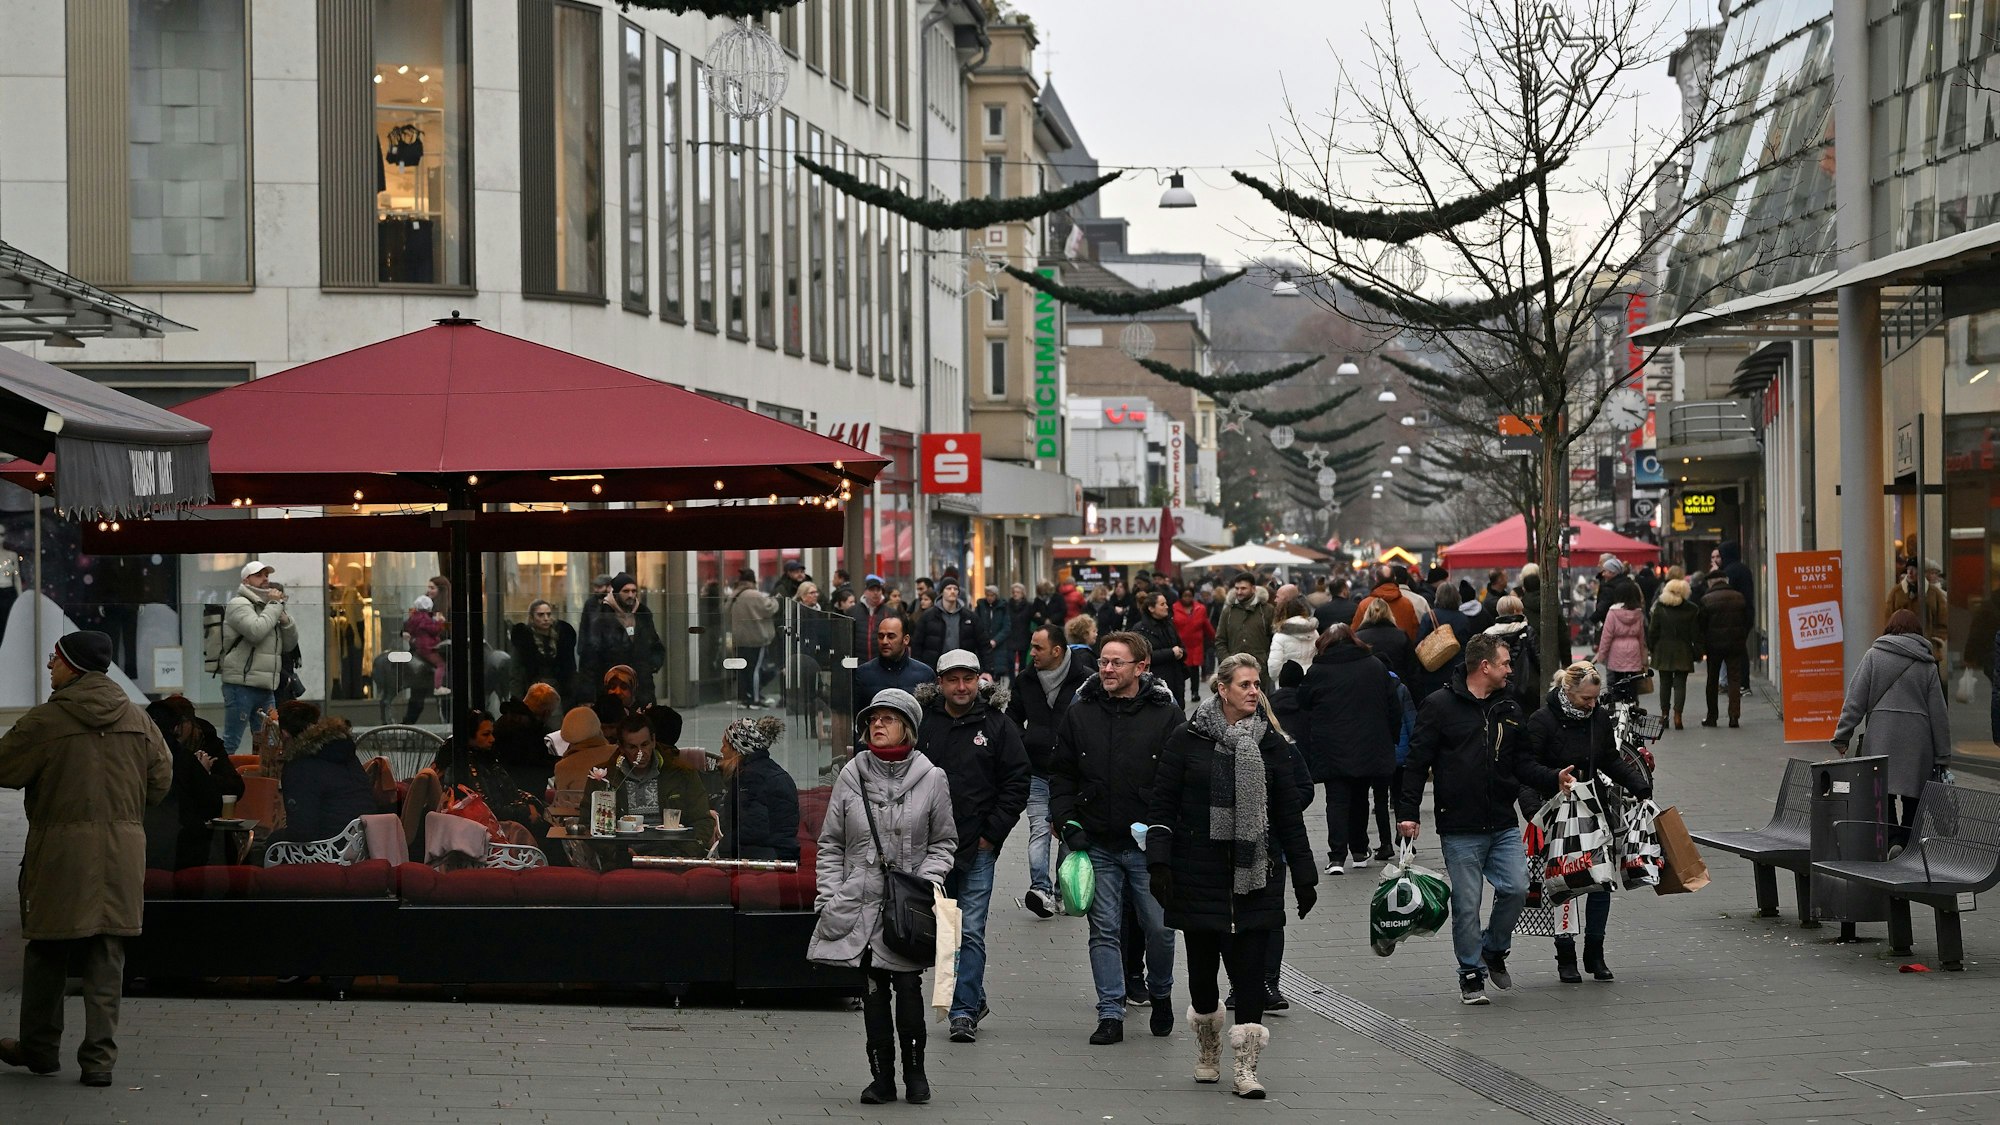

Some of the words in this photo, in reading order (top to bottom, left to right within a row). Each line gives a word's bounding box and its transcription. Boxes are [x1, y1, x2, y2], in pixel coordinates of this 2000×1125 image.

[1684, 494, 1716, 506] GOLD
[1097, 516, 1185, 534] BREMR
[1794, 565, 1833, 574] INSIDER
[1801, 573, 1827, 582] DAYS
[1798, 613, 1834, 631] 20%
[1800, 626, 1835, 638] RABATT
[1380, 919, 1412, 928] DEICHM
